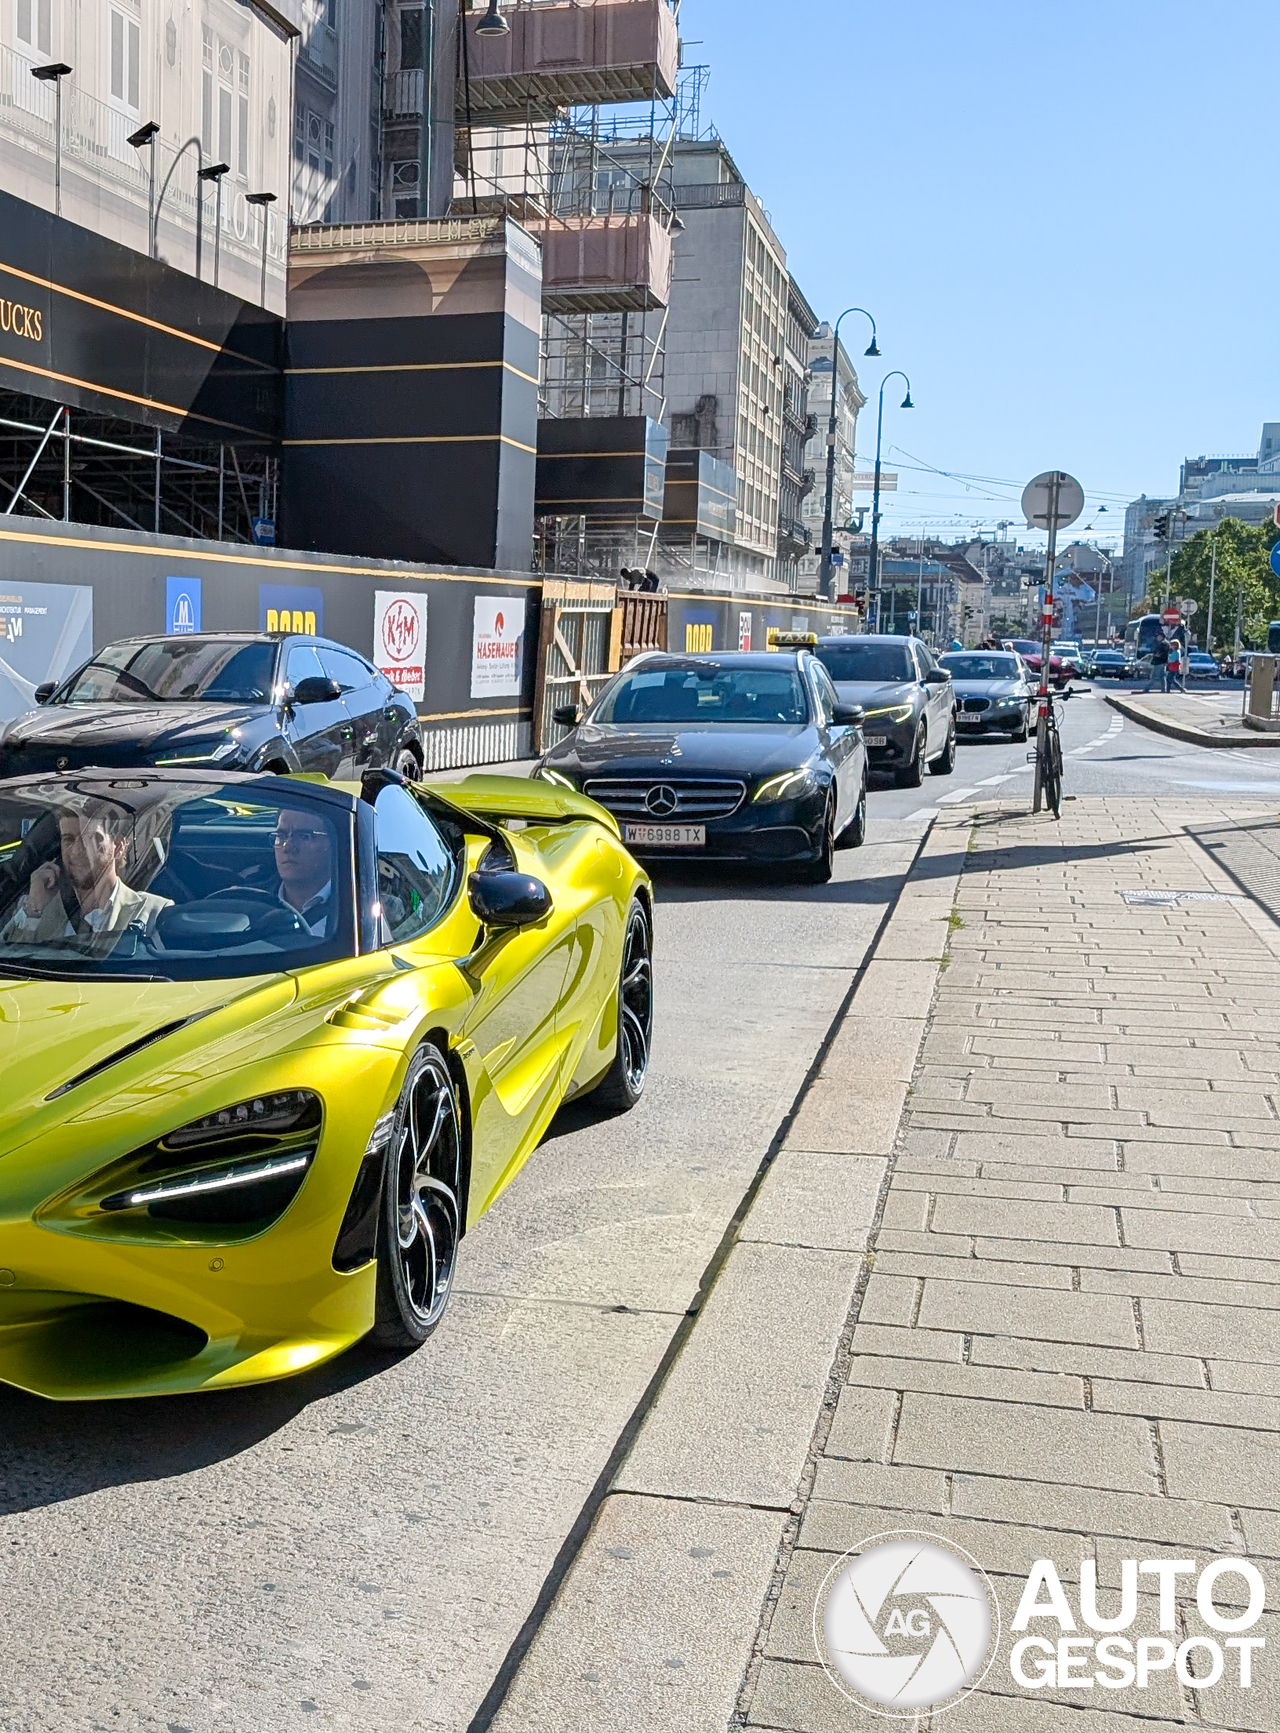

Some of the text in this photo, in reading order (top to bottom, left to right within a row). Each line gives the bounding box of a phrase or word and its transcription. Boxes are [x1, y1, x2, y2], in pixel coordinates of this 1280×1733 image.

[778, 634, 810, 642] TAXI
[628, 828, 701, 842] W 6988 TX
